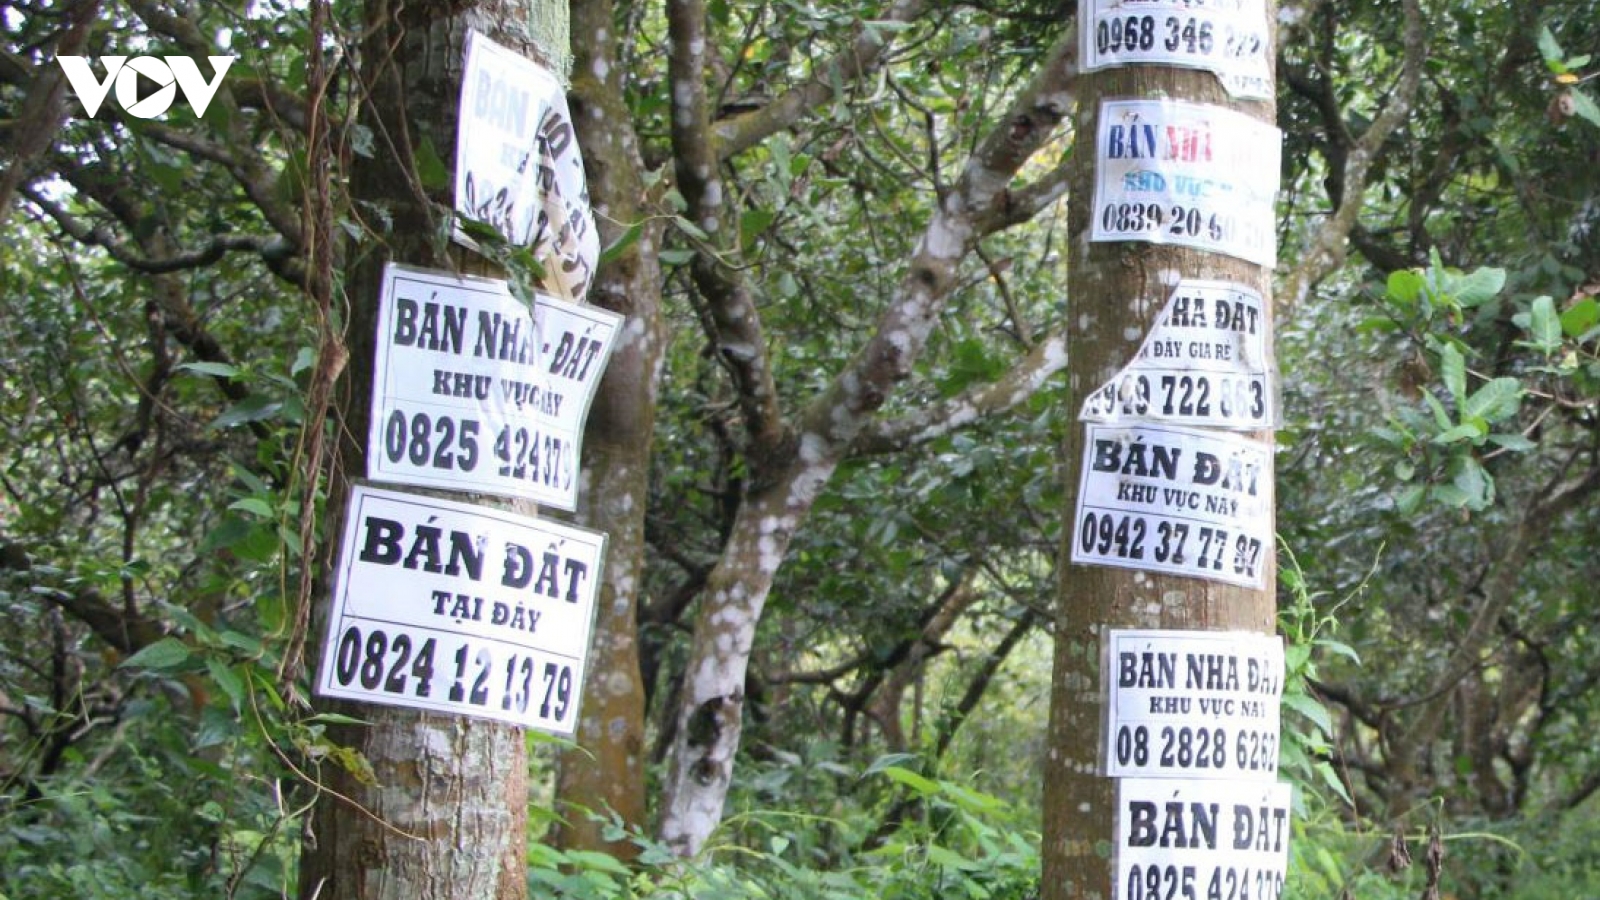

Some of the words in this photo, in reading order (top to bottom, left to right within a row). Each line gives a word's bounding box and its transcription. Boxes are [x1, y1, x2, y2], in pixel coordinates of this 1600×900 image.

[1097, 16, 1155, 55] 0968
[1165, 17, 1214, 54] 346
[1108, 112, 1158, 160] BÁN
[1102, 203, 1162, 233] 0839
[1169, 206, 1201, 237] 20
[1162, 290, 1207, 328] HÀ
[1215, 292, 1258, 335] ĐẤT
[394, 291, 468, 355] BÁN
[549, 324, 602, 382] ĐẤT
[1153, 337, 1182, 358] ĐÂY
[432, 369, 492, 401] KHU
[1161, 376, 1211, 417] 722
[385, 409, 480, 472] 0825
[1092, 436, 1182, 481] BÁN
[1117, 482, 1157, 505] KHU
[1163, 488, 1199, 512] VỰC
[359, 515, 488, 581] BÁN
[501, 539, 588, 604] ĐẤT
[1082, 512, 1147, 560] 0942
[1155, 520, 1189, 565] 37
[1198, 527, 1228, 570] 77
[432, 590, 484, 624] TẠI
[490, 600, 542, 633] ĐÂY
[336, 626, 438, 698] 0824
[448, 643, 492, 706] 12
[501, 652, 534, 714] 13
[539, 663, 573, 722] 79
[1119, 643, 1177, 689] BÁN
[1150, 697, 1191, 714] KHU
[1199, 698, 1235, 720] VỰC
[1117, 725, 1149, 767] 08
[1160, 726, 1227, 769] 2828
[1236, 729, 1276, 772] 6262
[1128, 790, 1220, 850] BÁN
[1128, 863, 1197, 900] 0825
